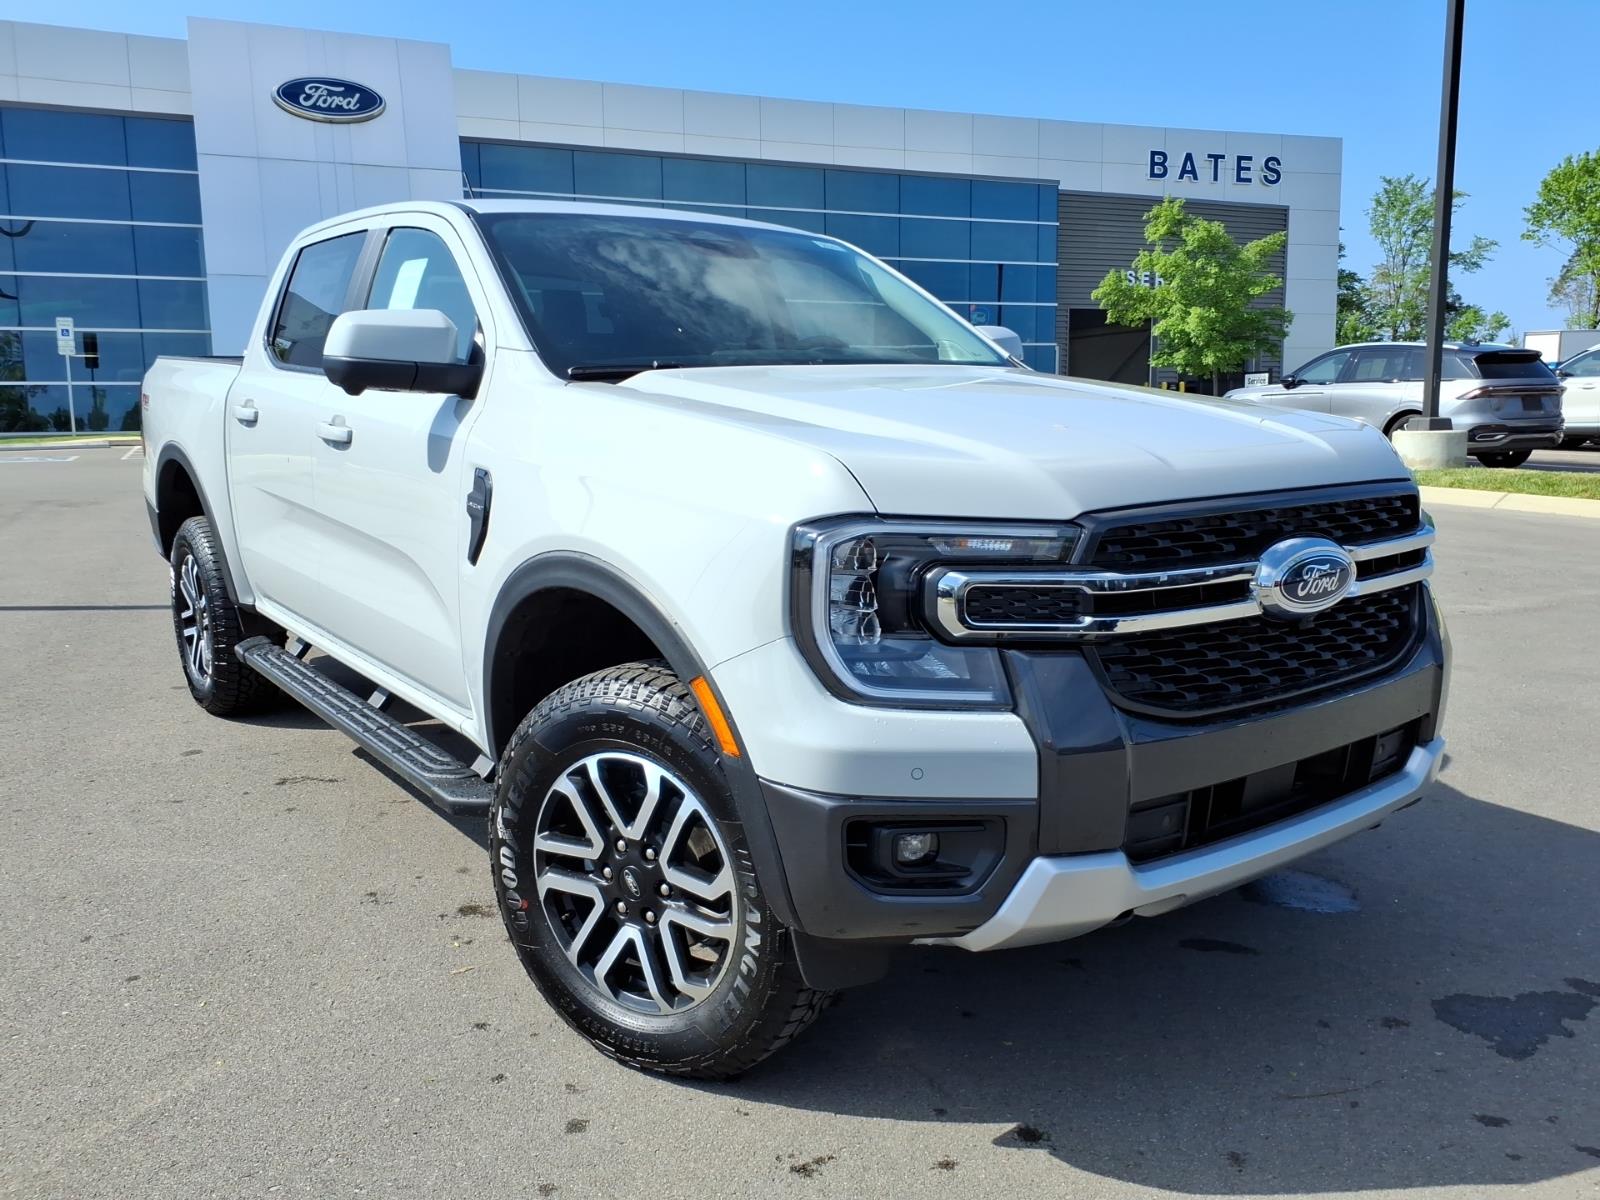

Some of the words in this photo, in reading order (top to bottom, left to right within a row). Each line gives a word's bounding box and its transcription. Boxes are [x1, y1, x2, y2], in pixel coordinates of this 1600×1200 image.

[299, 82, 361, 111] Ford
[1147, 150, 1283, 186] BATES
[1297, 563, 1341, 597] Ford
